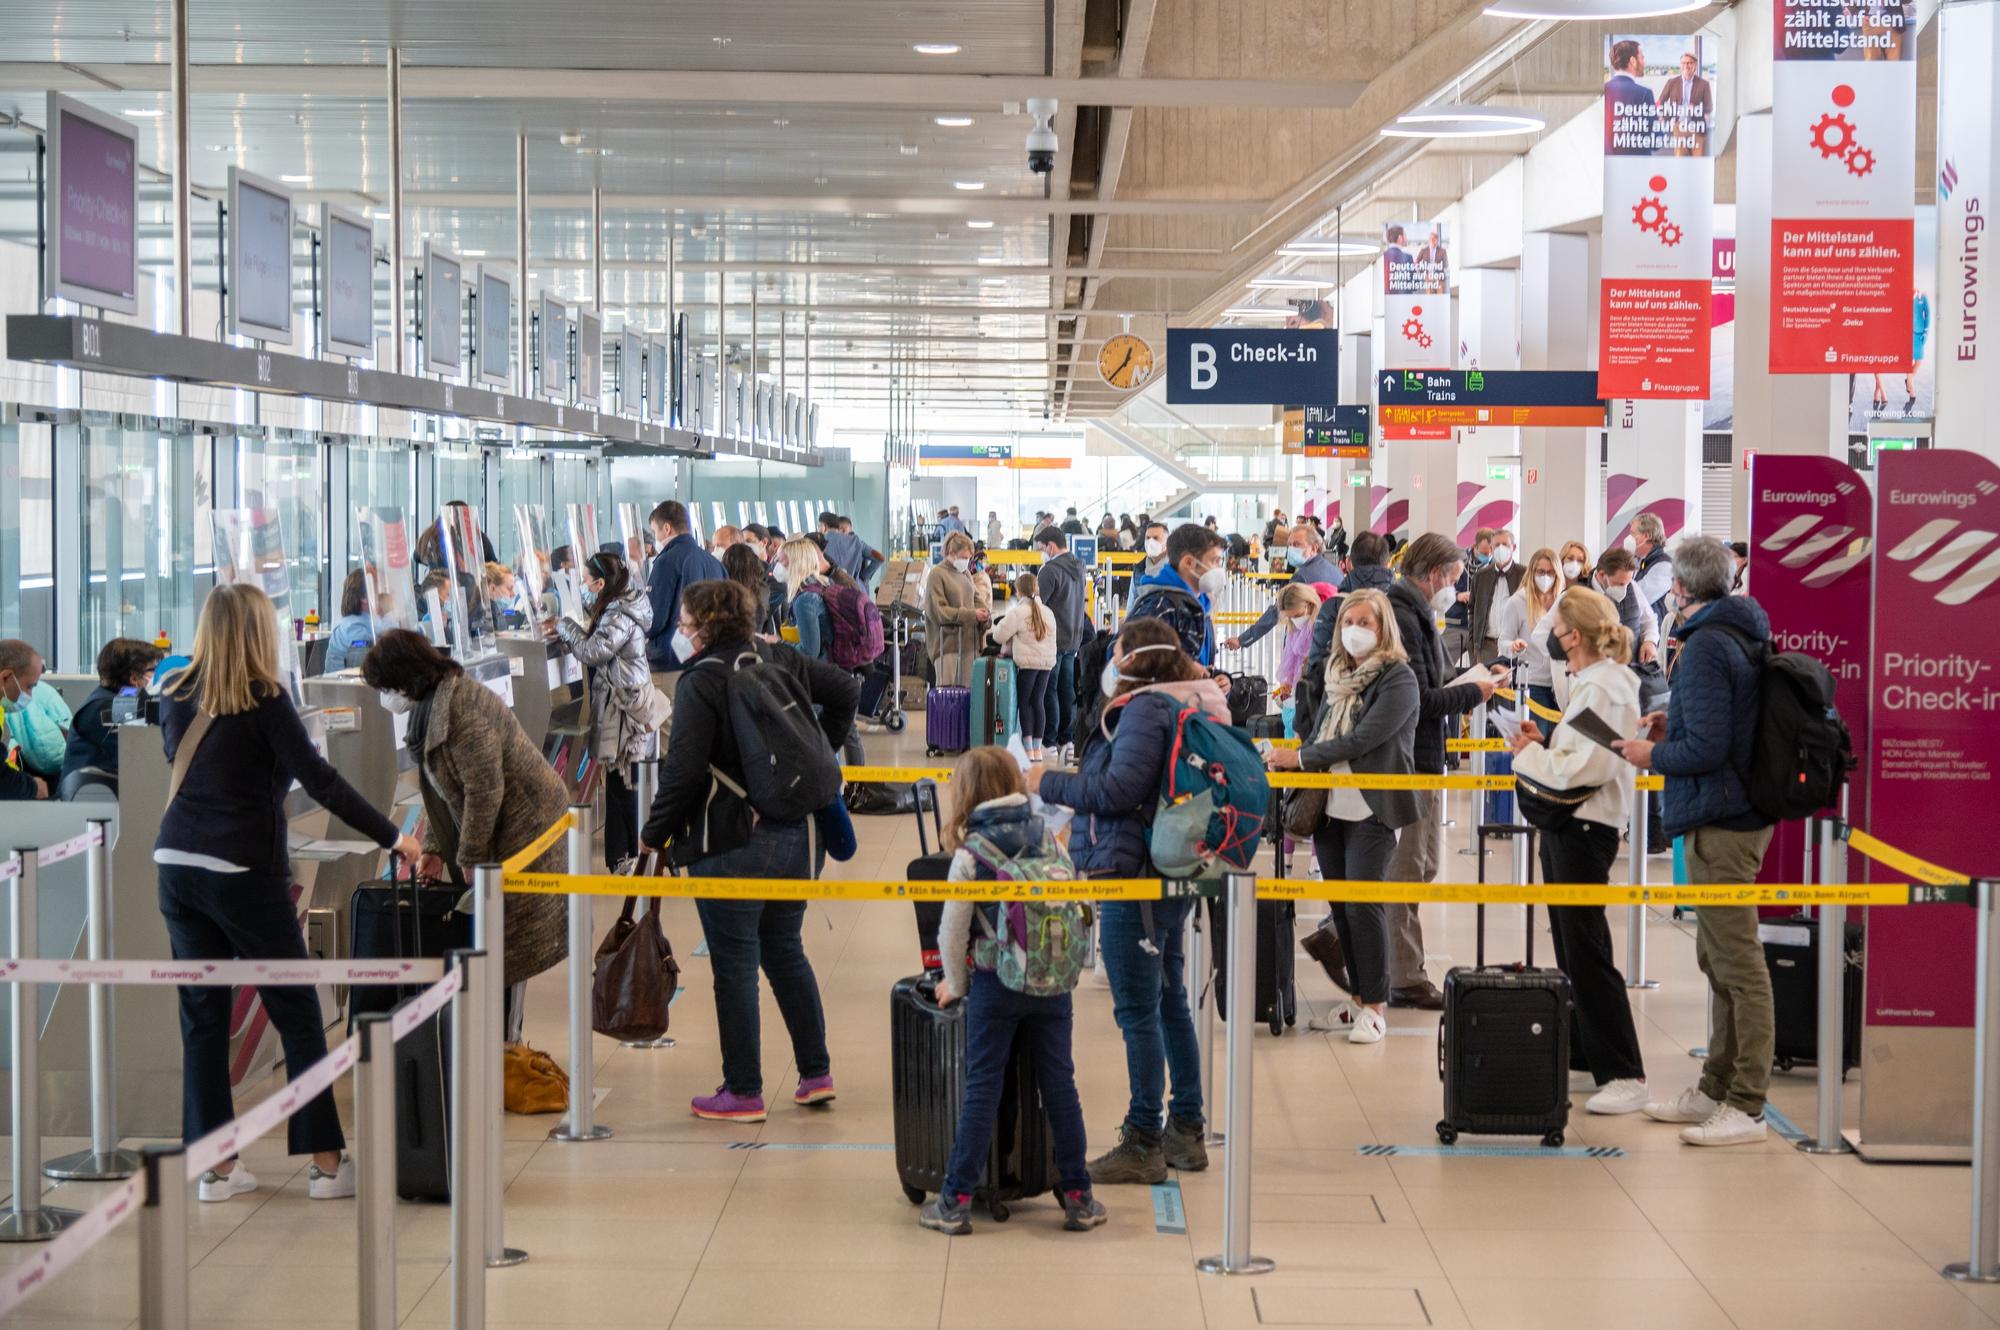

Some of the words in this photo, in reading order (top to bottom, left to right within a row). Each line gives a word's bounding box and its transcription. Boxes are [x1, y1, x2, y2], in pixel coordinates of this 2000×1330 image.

[1784, 11, 1831, 28] zählt
[1835, 11, 1866, 28] auf
[1869, 11, 1903, 28] den
[1785, 31, 1897, 49] Mittelstand.
[1613, 101, 1704, 117] Deutschland
[1613, 117, 1649, 133] zählt
[1652, 117, 1675, 133] auf
[1679, 118, 1705, 133] den
[1613, 133, 1700, 149] Mittelstand.
[1783, 231, 1804, 243] Der
[1807, 231, 1874, 243] Mittelstand
[1783, 246, 1812, 257] kann
[1814, 246, 1834, 257] auf
[1835, 248, 1857, 258] uns
[1859, 246, 1901, 259] zählen.
[1957, 197, 1984, 361] Eurowings
[1610, 289, 1626, 297] Der
[1629, 288, 1681, 298] Mittelstand
[1610, 300, 1632, 309] kann
[1634, 300, 1649, 309] auf
[1669, 300, 1702, 310] zählen.
[83, 323, 101, 357] B01
[1841, 353, 1899, 364] Finanzgruppe
[258, 355, 271, 382] B02
[1190, 343, 1218, 390] B
[1231, 343, 1317, 362] Check-in
[1427, 376, 1451, 387] Bahn
[1654, 383, 1700, 393] Finanzgruppe
[1427, 390, 1456, 401] Trains
[1762, 489, 1837, 506] Eurowings
[1889, 489, 1976, 508] Eurowings
[1884, 653, 1991, 684] Priority-
[503, 877, 525, 887] Bonn
[528, 878, 560, 889] Airport
[909, 886, 928, 895] Köln
[931, 886, 951, 895] Bonn
[954, 886, 986, 896] Airport
[1047, 886, 1065, 895] Köln
[1068, 886, 1089, 894] Bonn
[1093, 886, 1124, 896] Airport
[1273, 885, 1304, 895] Airport
[1654, 890, 1673, 899] Köln
[1676, 891, 1697, 899] Bonn
[1700, 890, 1732, 901] Airport
[1792, 890, 1811, 899] Köln
[1814, 890, 1834, 899] Bonn
[1838, 890, 1870, 901] Airport
[151, 969, 203, 981] Eurowings
[348, 968, 400, 979] Eurowings
